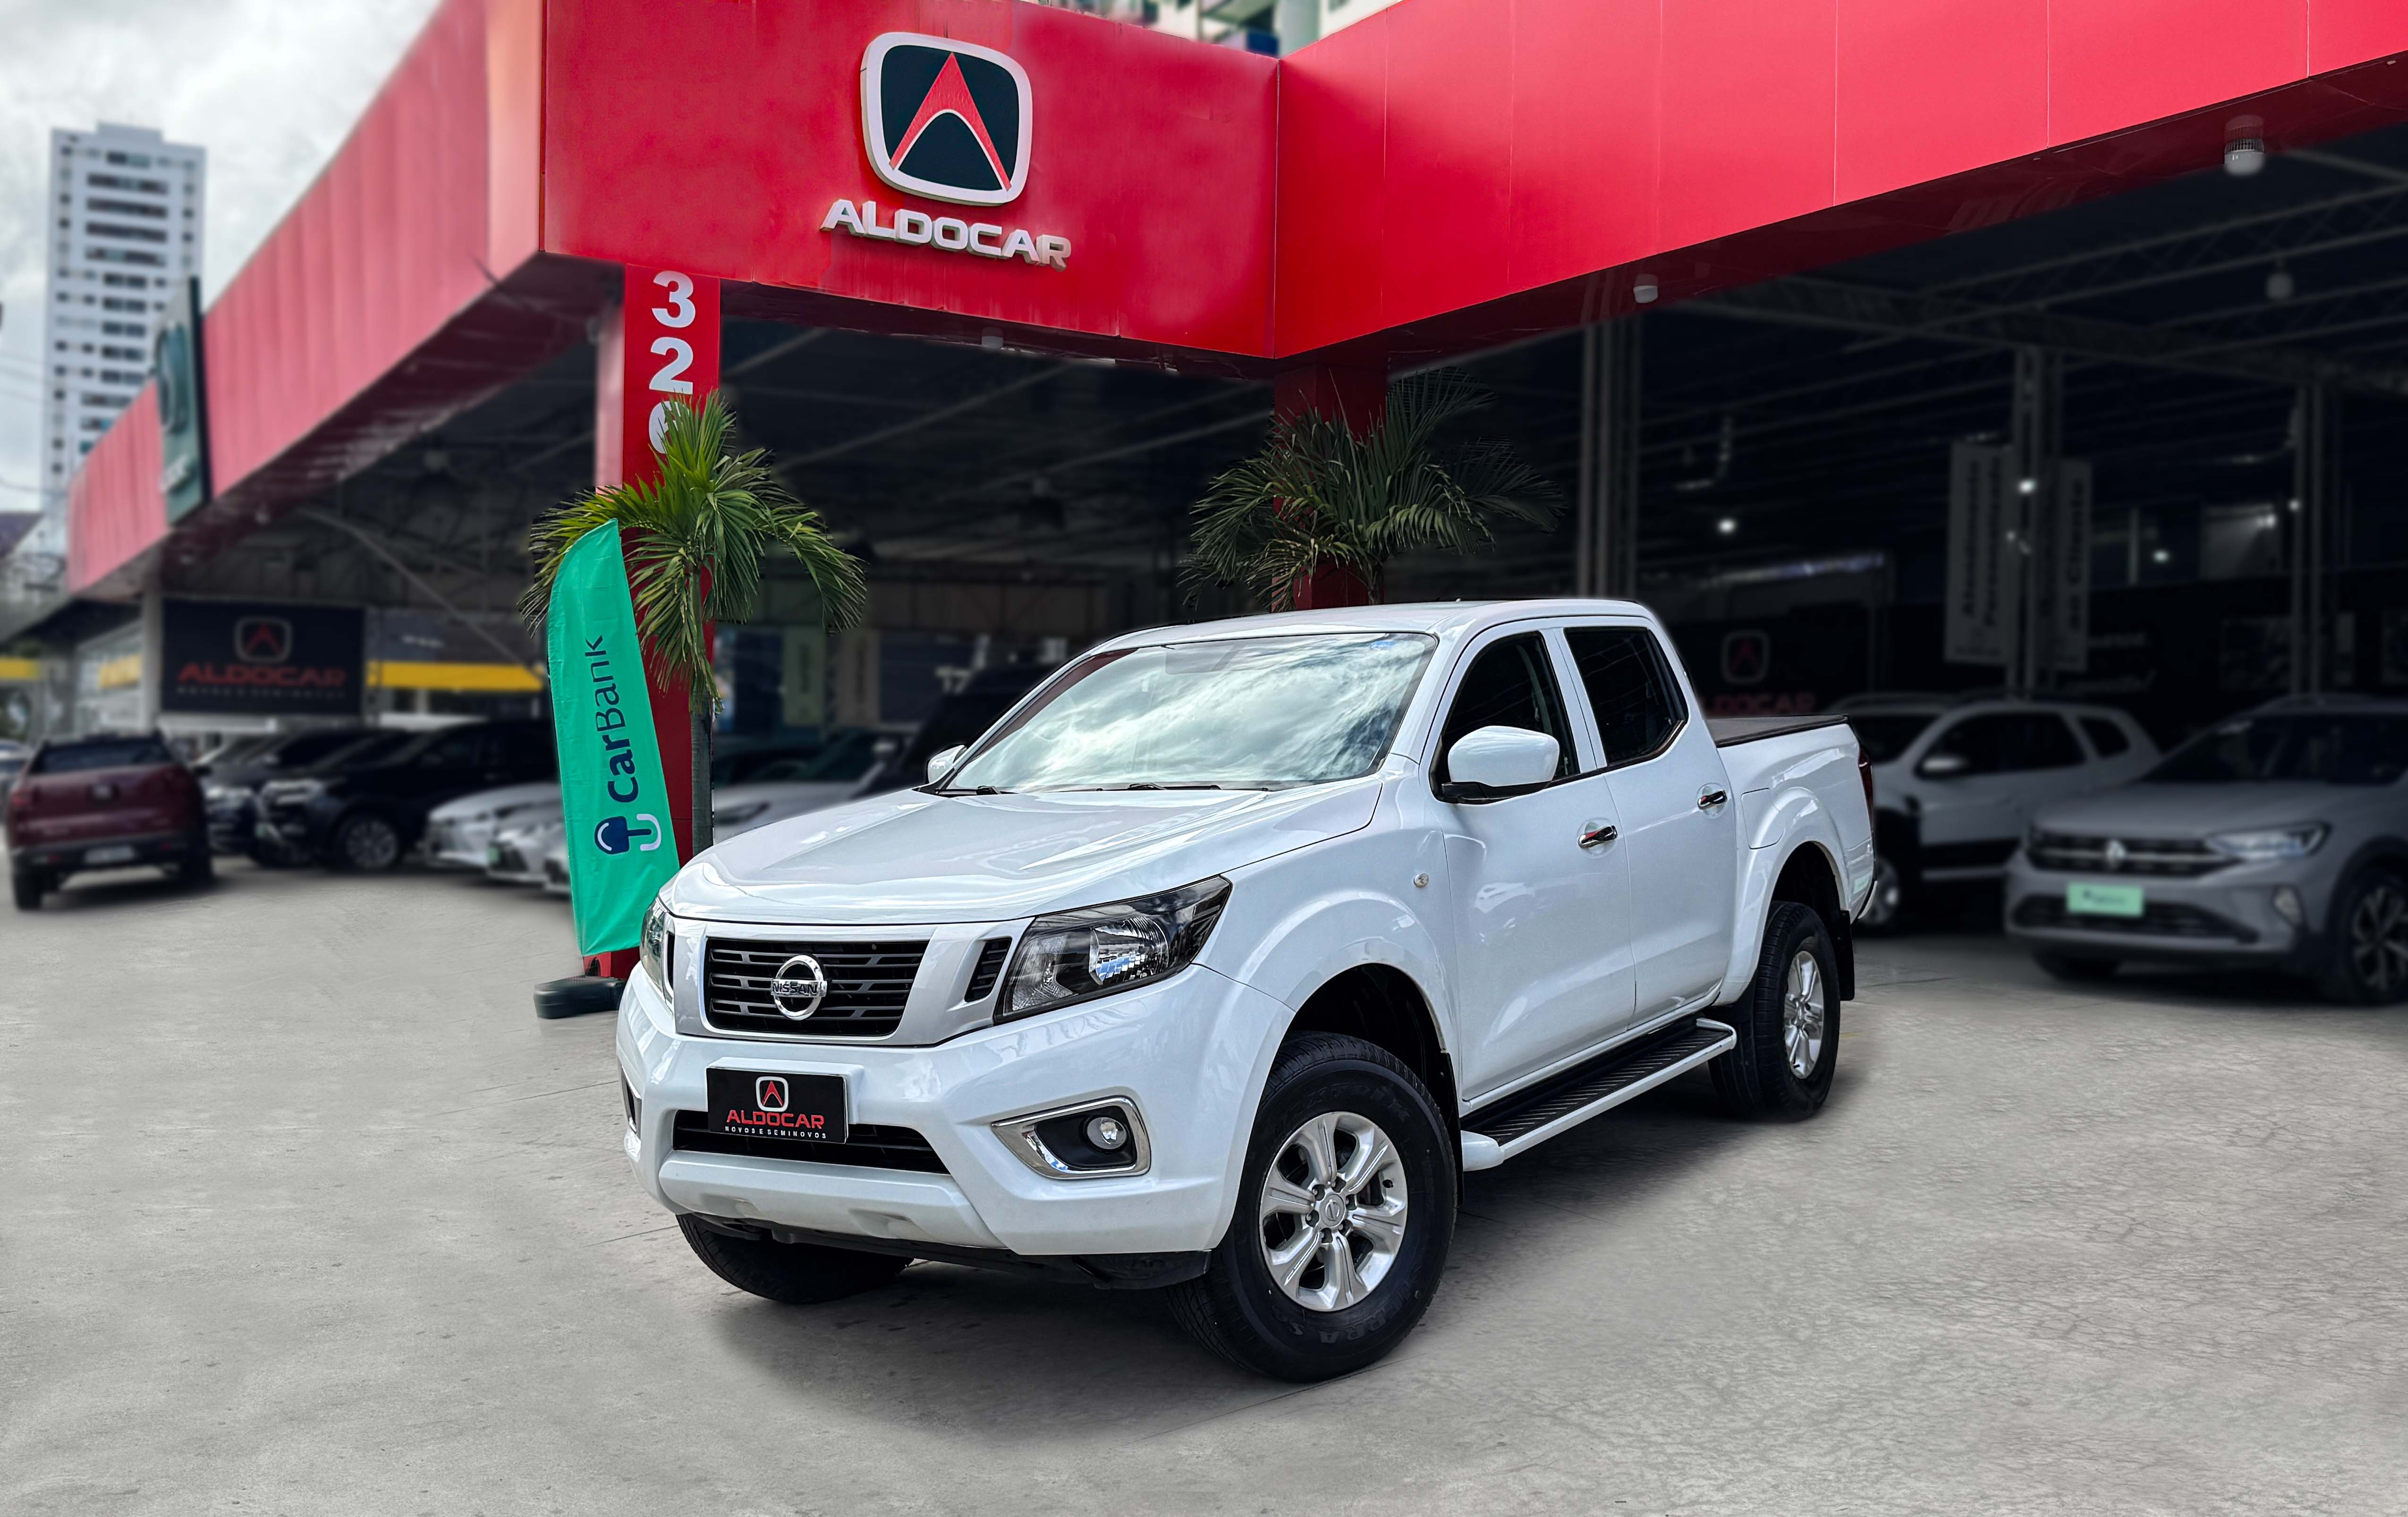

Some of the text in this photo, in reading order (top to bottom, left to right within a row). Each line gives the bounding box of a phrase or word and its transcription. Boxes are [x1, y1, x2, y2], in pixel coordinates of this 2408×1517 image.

[820, 199, 1071, 271] ALDOCAR
[178, 662, 347, 686] ALDOCAR
[1701, 690, 1816, 716] LDOCAR
[584, 635, 639, 803] CarBank
[773, 981, 817, 996] NISSAN
[726, 1110, 825, 1129] ALDOCAR
[725, 1126, 755, 1134] NOVOS
[767, 1129, 826, 1139] SEMINOVOS
